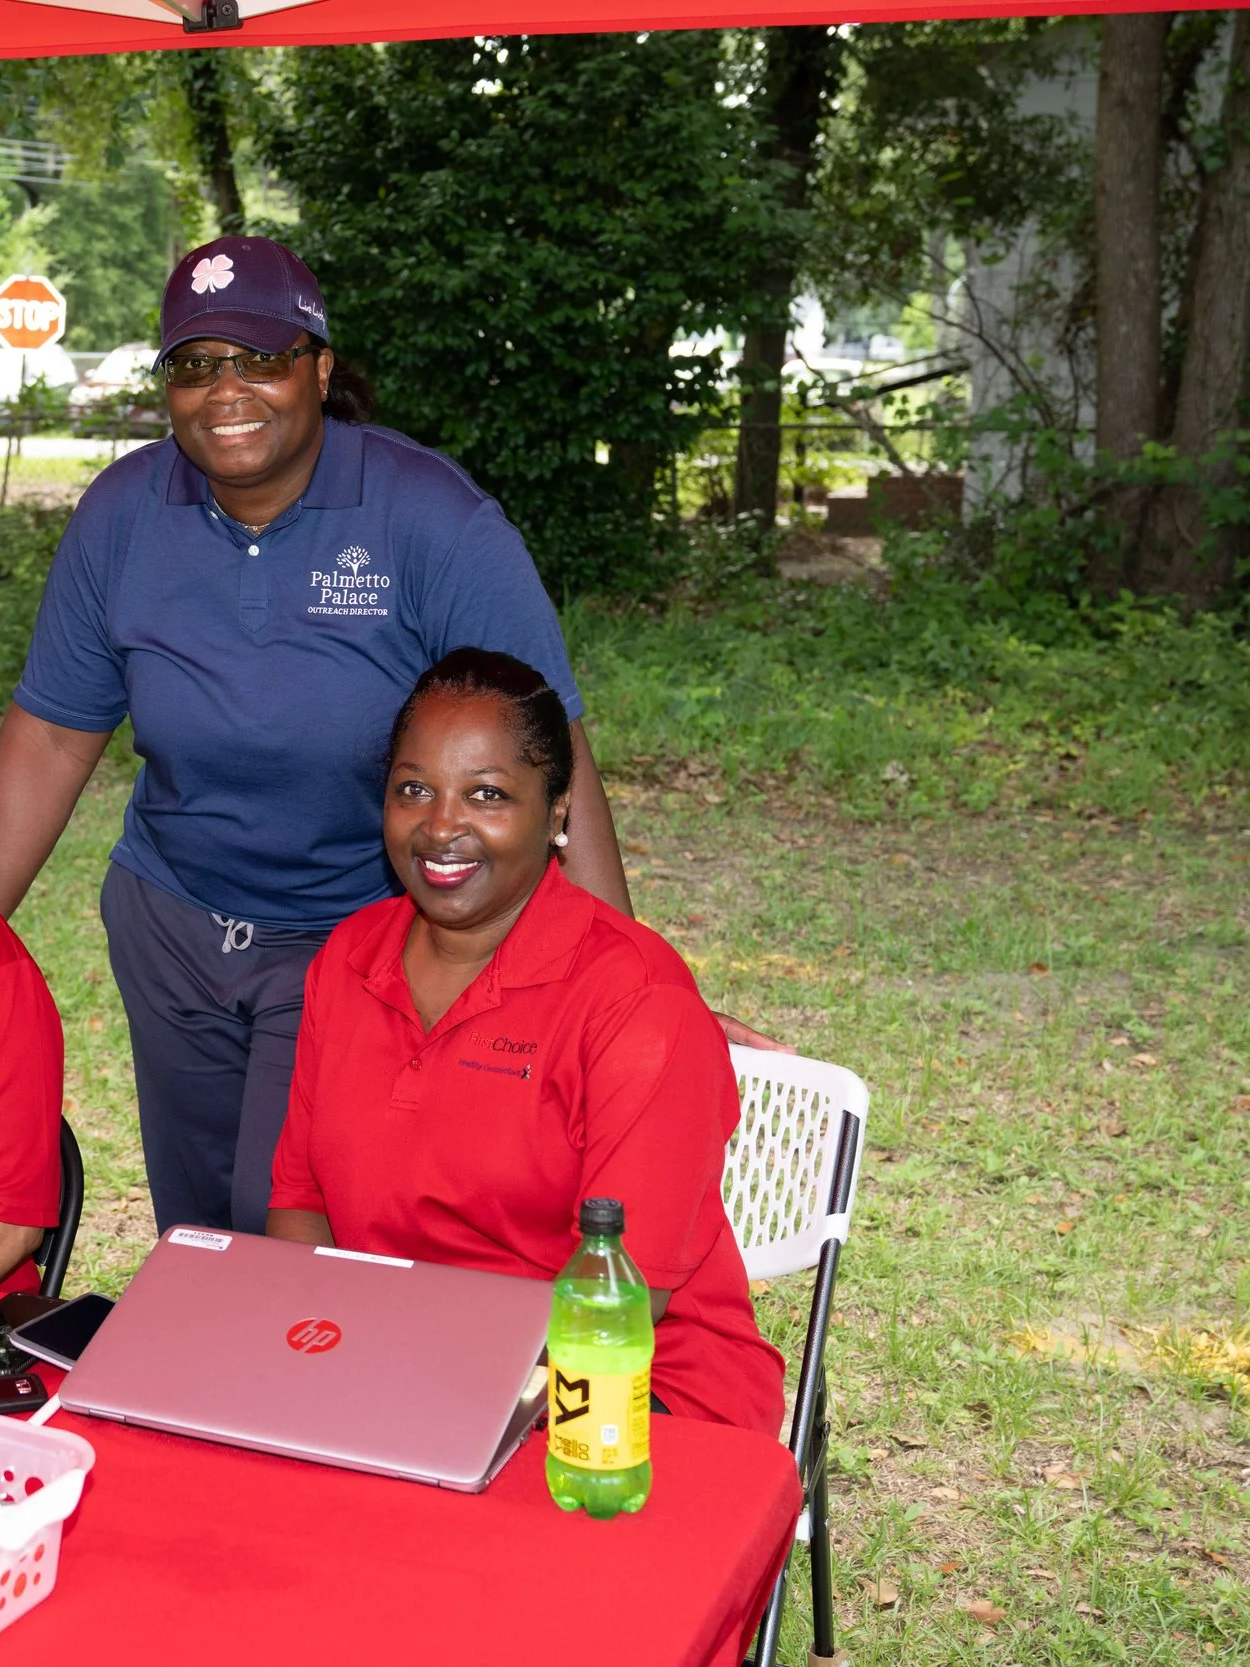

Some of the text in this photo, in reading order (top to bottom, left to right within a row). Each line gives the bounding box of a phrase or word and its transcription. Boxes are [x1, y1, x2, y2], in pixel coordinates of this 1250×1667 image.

[310, 570, 391, 588] Palmetto
[319, 588, 378, 605] Palace
[307, 606, 389, 616] OUTREACH DIRECTOR
[288, 1318, 340, 1353] hp
